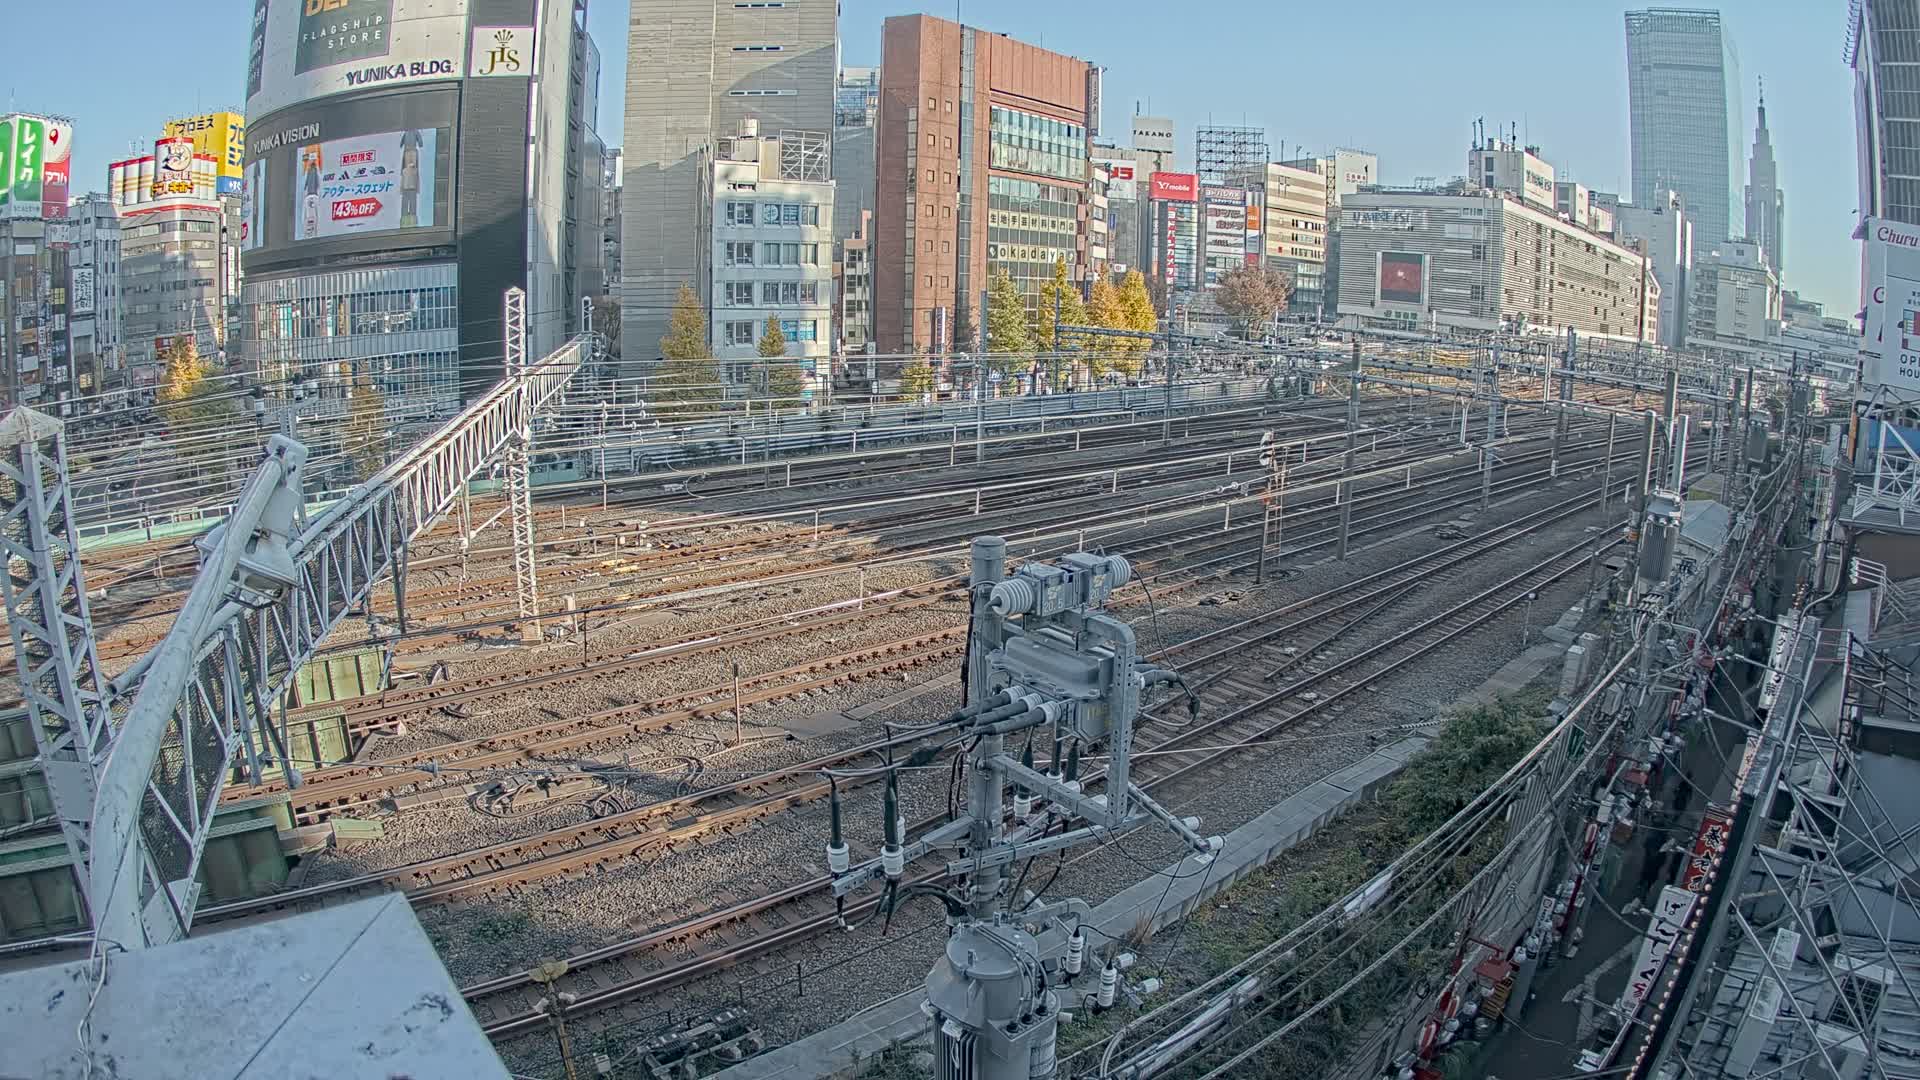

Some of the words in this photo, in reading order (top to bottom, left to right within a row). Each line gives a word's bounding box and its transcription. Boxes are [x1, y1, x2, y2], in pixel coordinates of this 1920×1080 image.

[303, 15, 383, 43] FLAGSHIP
[327, 30, 382, 49] STORE
[346, 64, 406, 86] YUNIKA
[410, 60, 455, 76] BLDG.
[175, 118, 215, 134] プロミス
[281, 122, 320, 145] VISION
[1133, 130, 1172, 138] TAKANO
[20, 122, 36, 188] レイク
[1877, 226, 1919, 247] Churu
